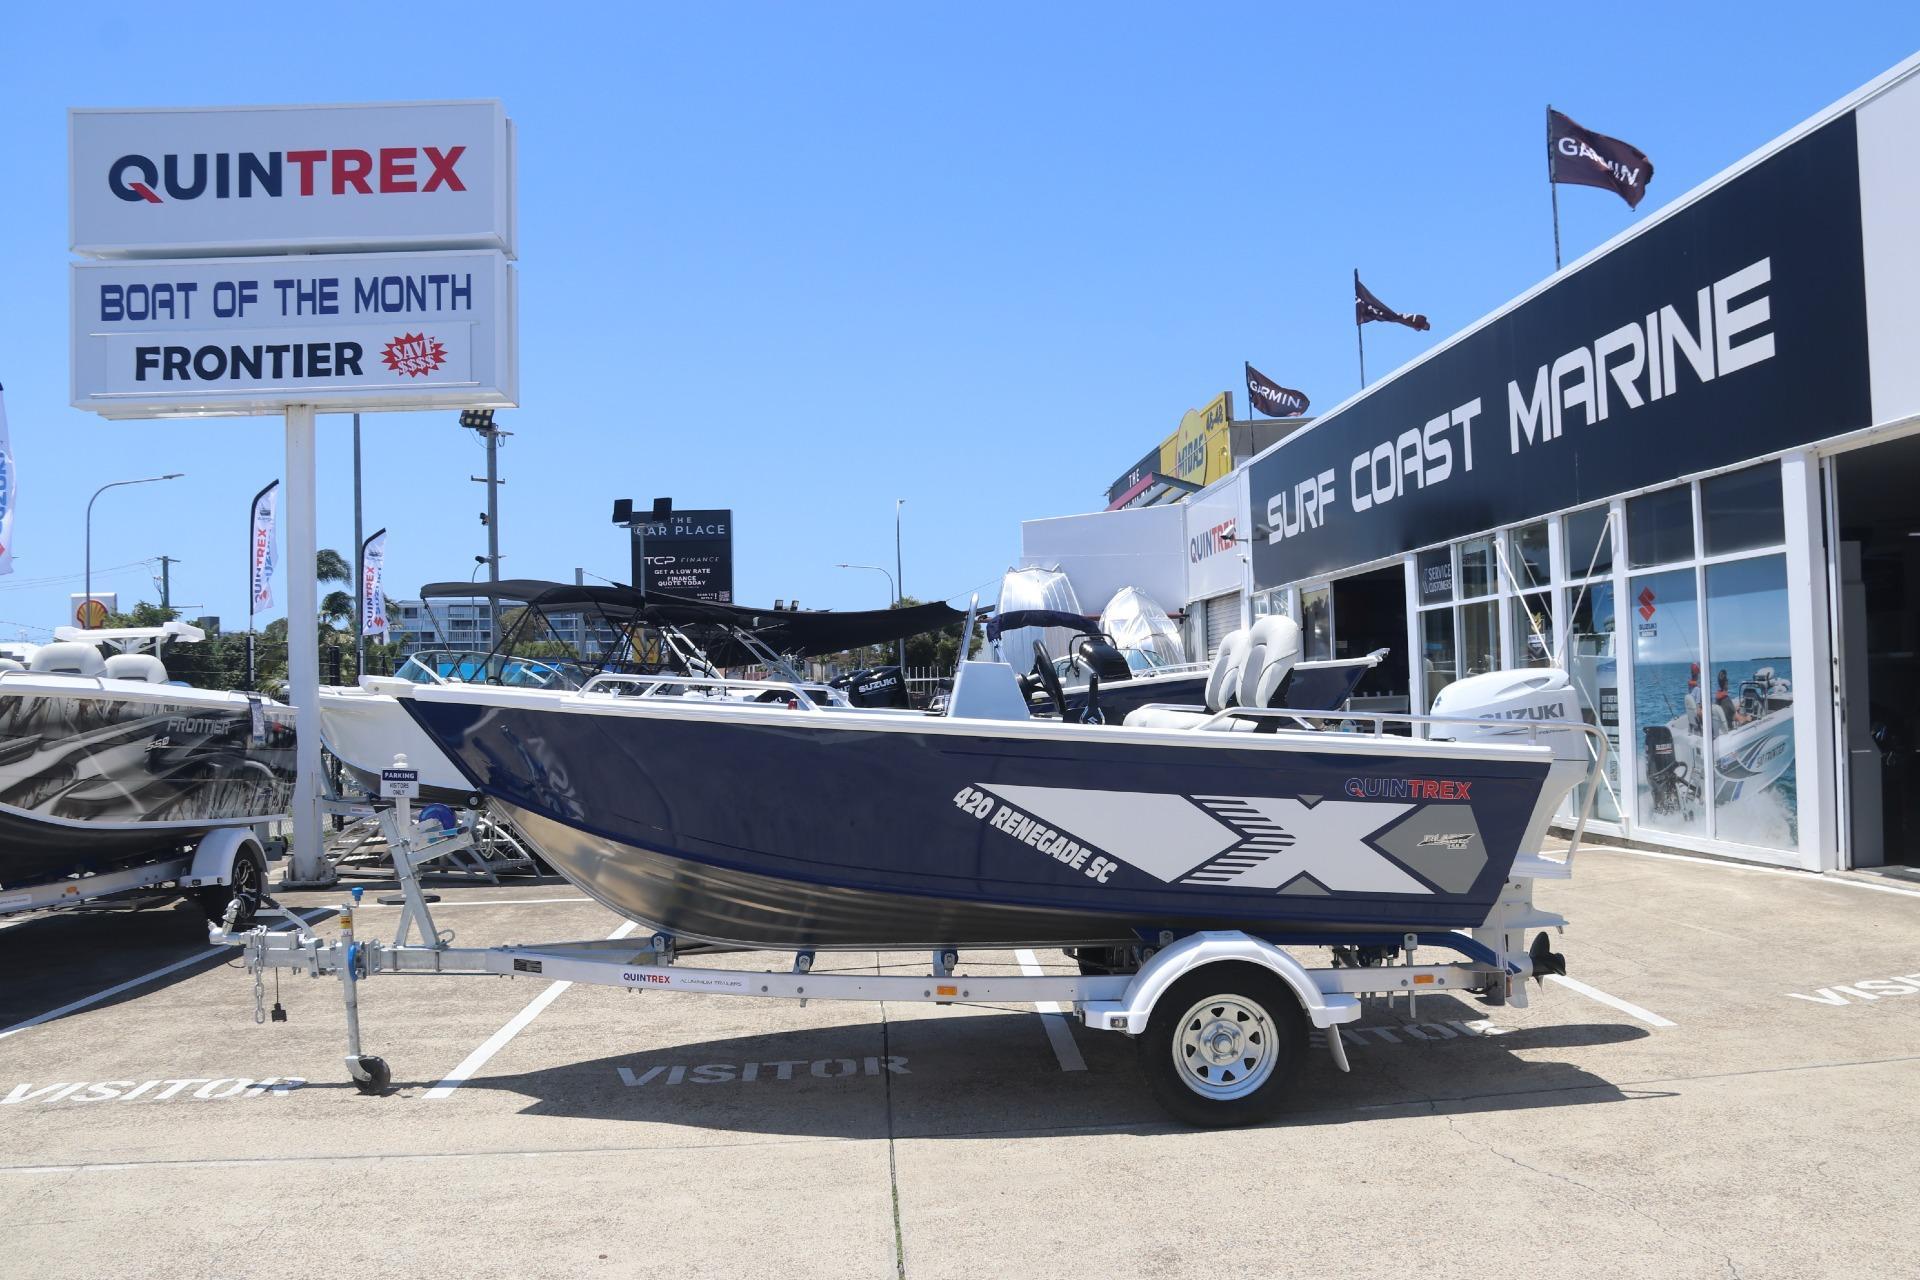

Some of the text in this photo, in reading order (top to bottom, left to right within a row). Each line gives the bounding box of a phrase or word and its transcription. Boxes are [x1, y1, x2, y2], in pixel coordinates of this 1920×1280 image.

[1558, 137, 1640, 186] GAIN
[108, 146, 467, 204] QUINTREX
[100, 273, 472, 322] BOAT OF THE MONTH
[392, 335, 436, 361] SAVE
[135, 341, 364, 382] FRONTIER
[1267, 256, 1776, 545] SURF COAST MARINE
[670, 516, 693, 524] THE
[675, 524, 726, 535] PLACE
[643, 556, 676, 565] TCP
[1428, 563, 1452, 581] SERVICE
[366, 567, 375, 628] QUINTREX
[858, 677, 897, 693] SUZUKI
[166, 717, 232, 735] FRONTIER
[1344, 777, 1472, 801] QUINTREX
[952, 786, 1118, 884] 420 RENEGADE SC
[623, 972, 671, 985] QUINTREX
[1783, 973, 1920, 1006] VISI
[616, 1055, 913, 1087] VISITOR
[5, 1077, 307, 1101] VISITOR
